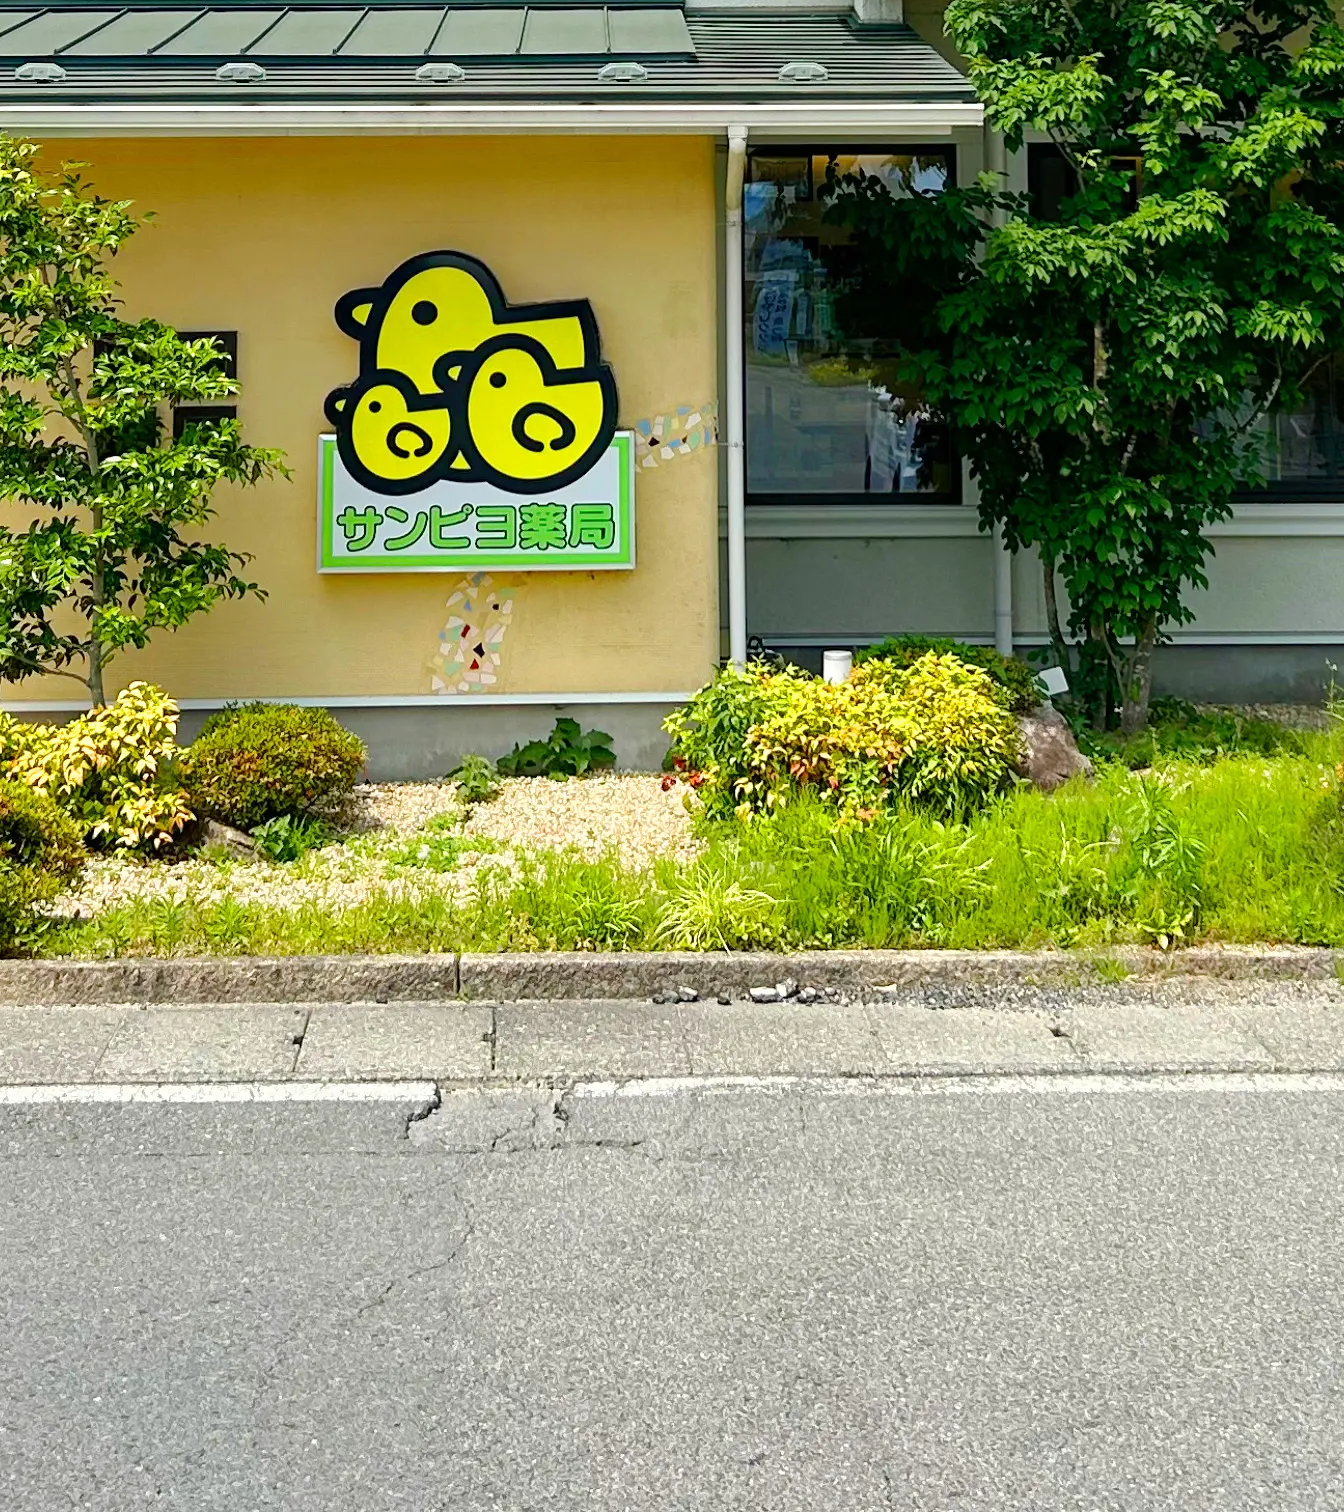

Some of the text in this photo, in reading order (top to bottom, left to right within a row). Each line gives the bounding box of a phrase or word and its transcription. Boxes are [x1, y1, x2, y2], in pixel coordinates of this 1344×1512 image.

[335, 502, 616, 552] サンピヨ薬局
